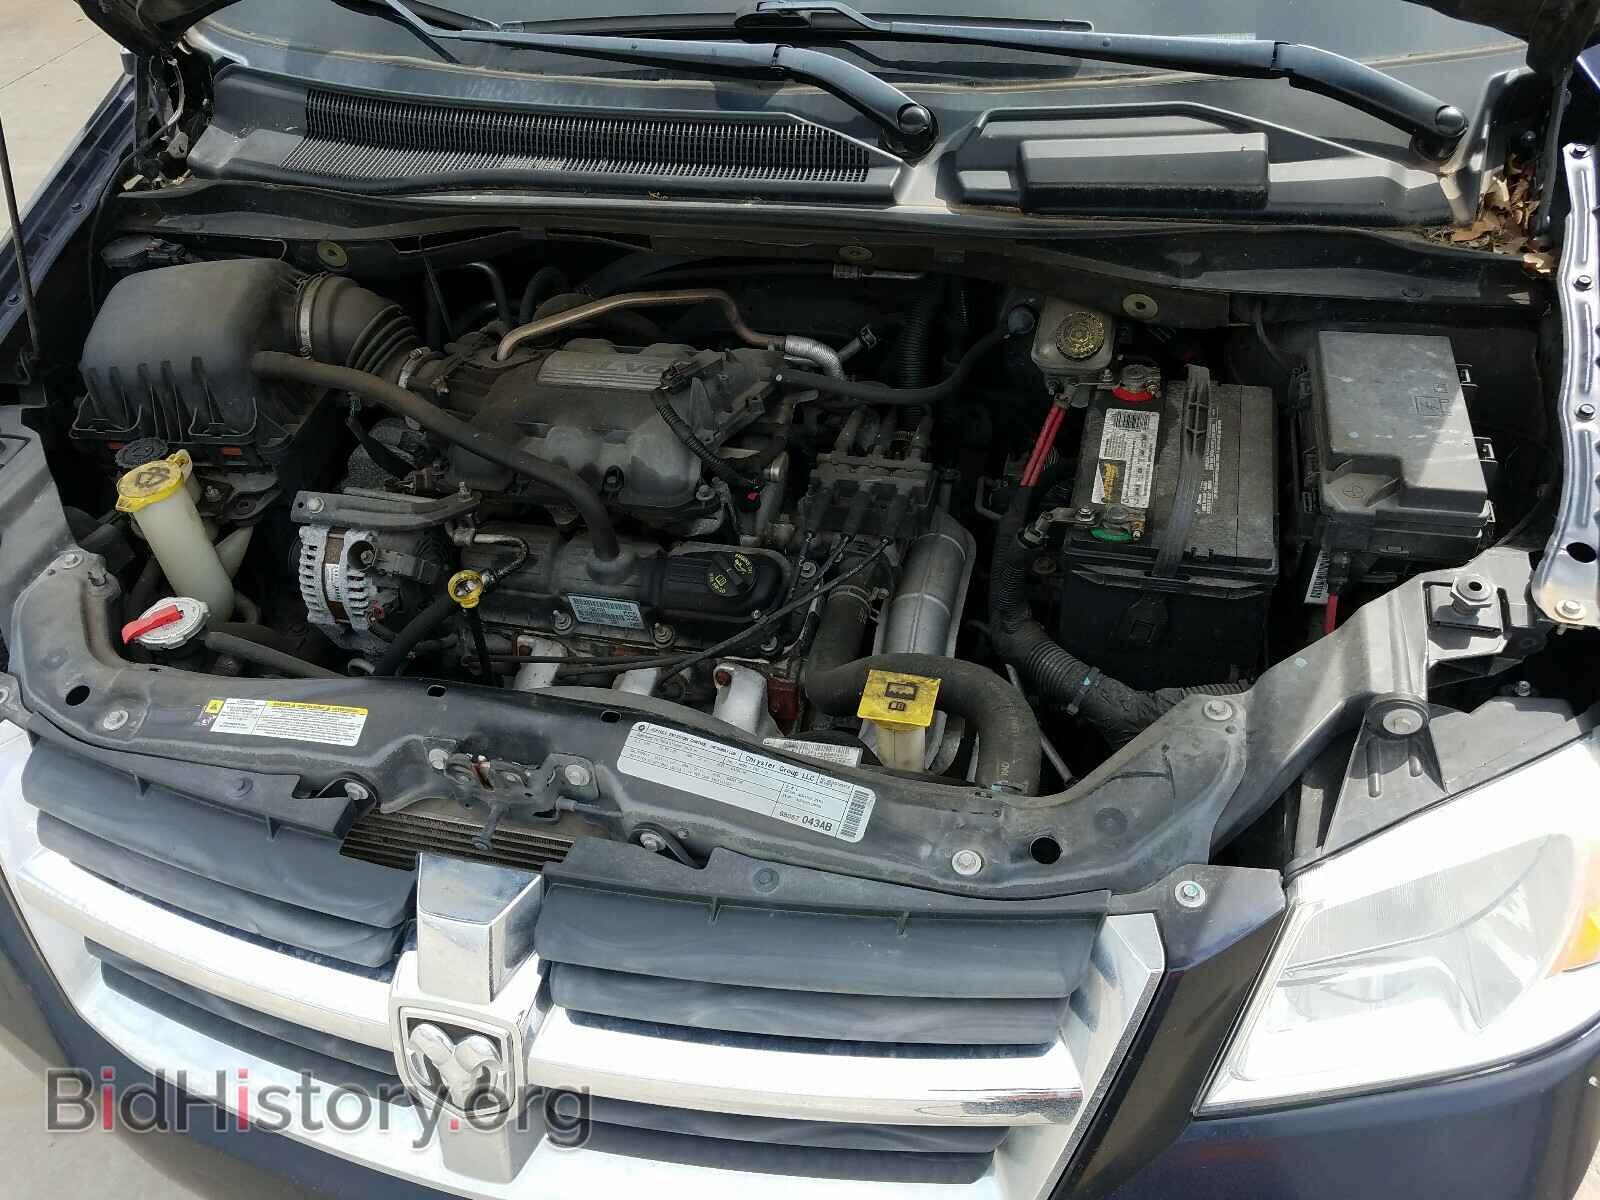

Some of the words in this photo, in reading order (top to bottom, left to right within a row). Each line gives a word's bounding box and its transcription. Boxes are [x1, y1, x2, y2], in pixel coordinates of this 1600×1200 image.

[745, 755, 776, 769] Chrysler
[779, 766, 799, 778] Group
[801, 773, 816, 782] LLC
[801, 815, 833, 832] 043AB
